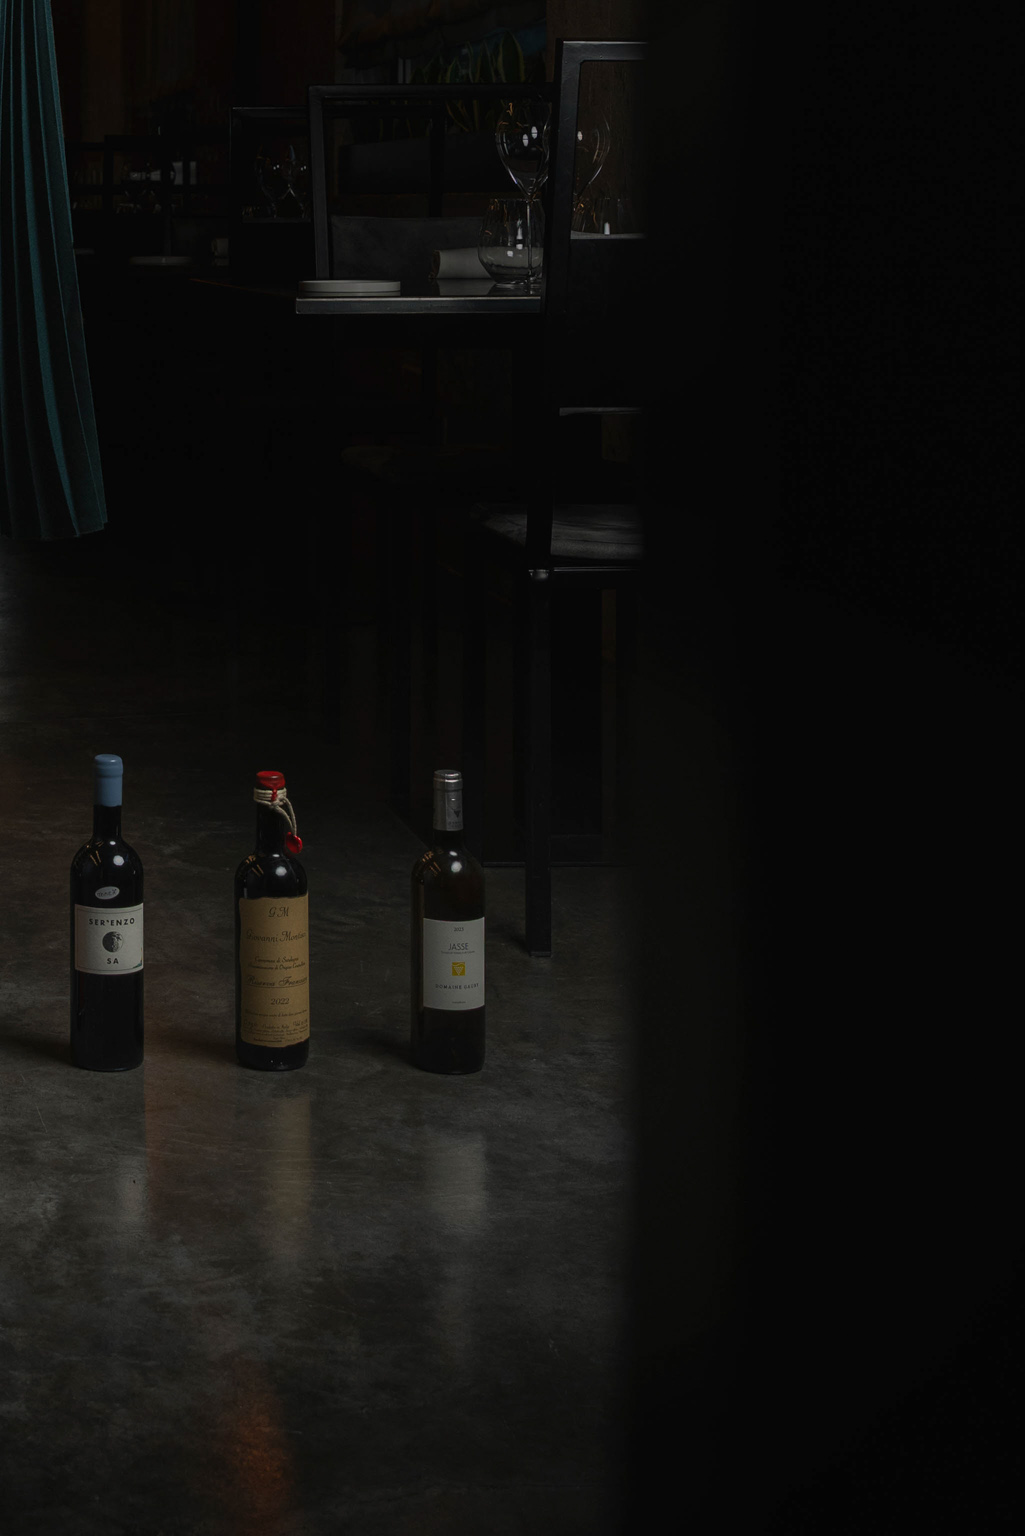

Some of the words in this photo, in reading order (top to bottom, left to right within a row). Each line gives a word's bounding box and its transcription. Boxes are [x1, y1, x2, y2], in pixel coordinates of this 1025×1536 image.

[246, 928, 279, 943] Giovanni
[448, 942, 469, 951] JASSE
[270, 997, 290, 1005] 2022
